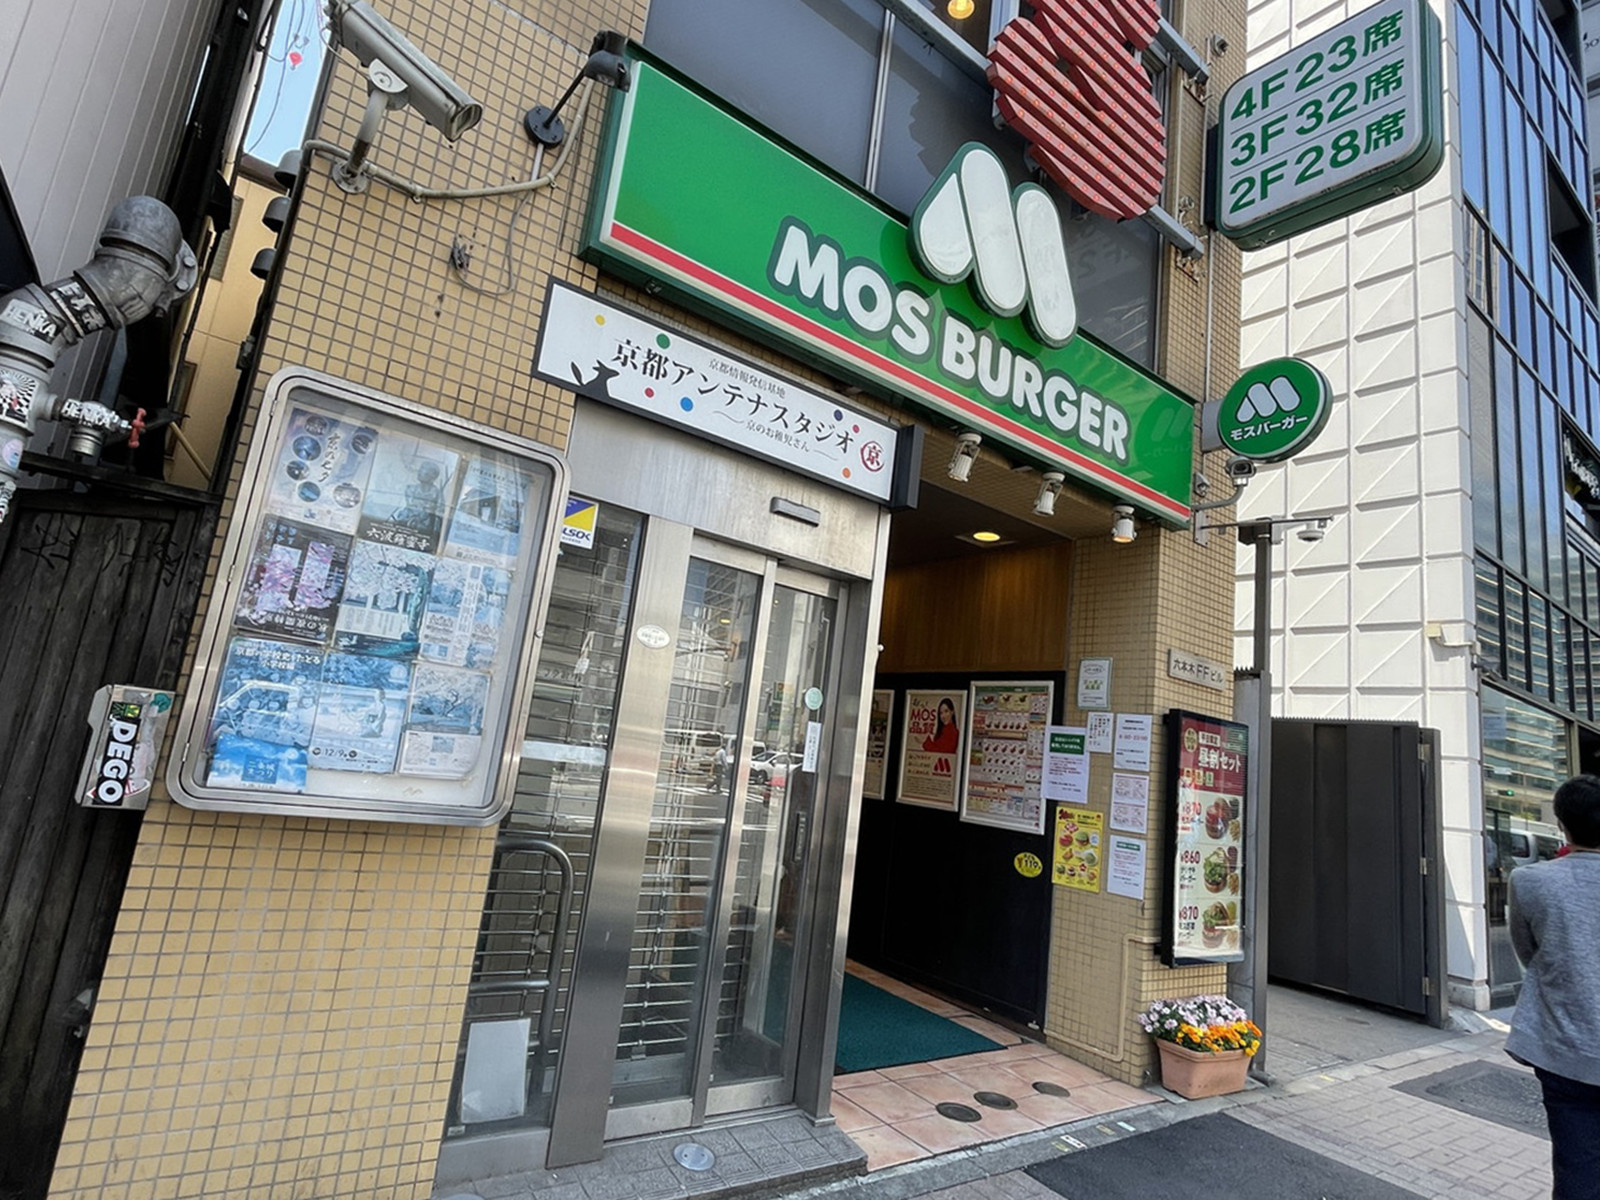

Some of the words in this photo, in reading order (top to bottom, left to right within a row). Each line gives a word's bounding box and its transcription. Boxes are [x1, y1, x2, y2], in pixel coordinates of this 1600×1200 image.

[773, 222, 932, 357] MOS
[941, 314, 1130, 461] BURGER
[708, 358, 786, 399] 京都情報発信基地
[611, 338, 854, 454] 京都アンテナスタジオ
[1230, 415, 1308, 441] モスバーガー
[562, 527, 591, 542] LSOK
[911, 708, 937, 721] MOS
[98, 720, 138, 804] DEGO
[1198, 746, 1242, 773] 昼割セット
